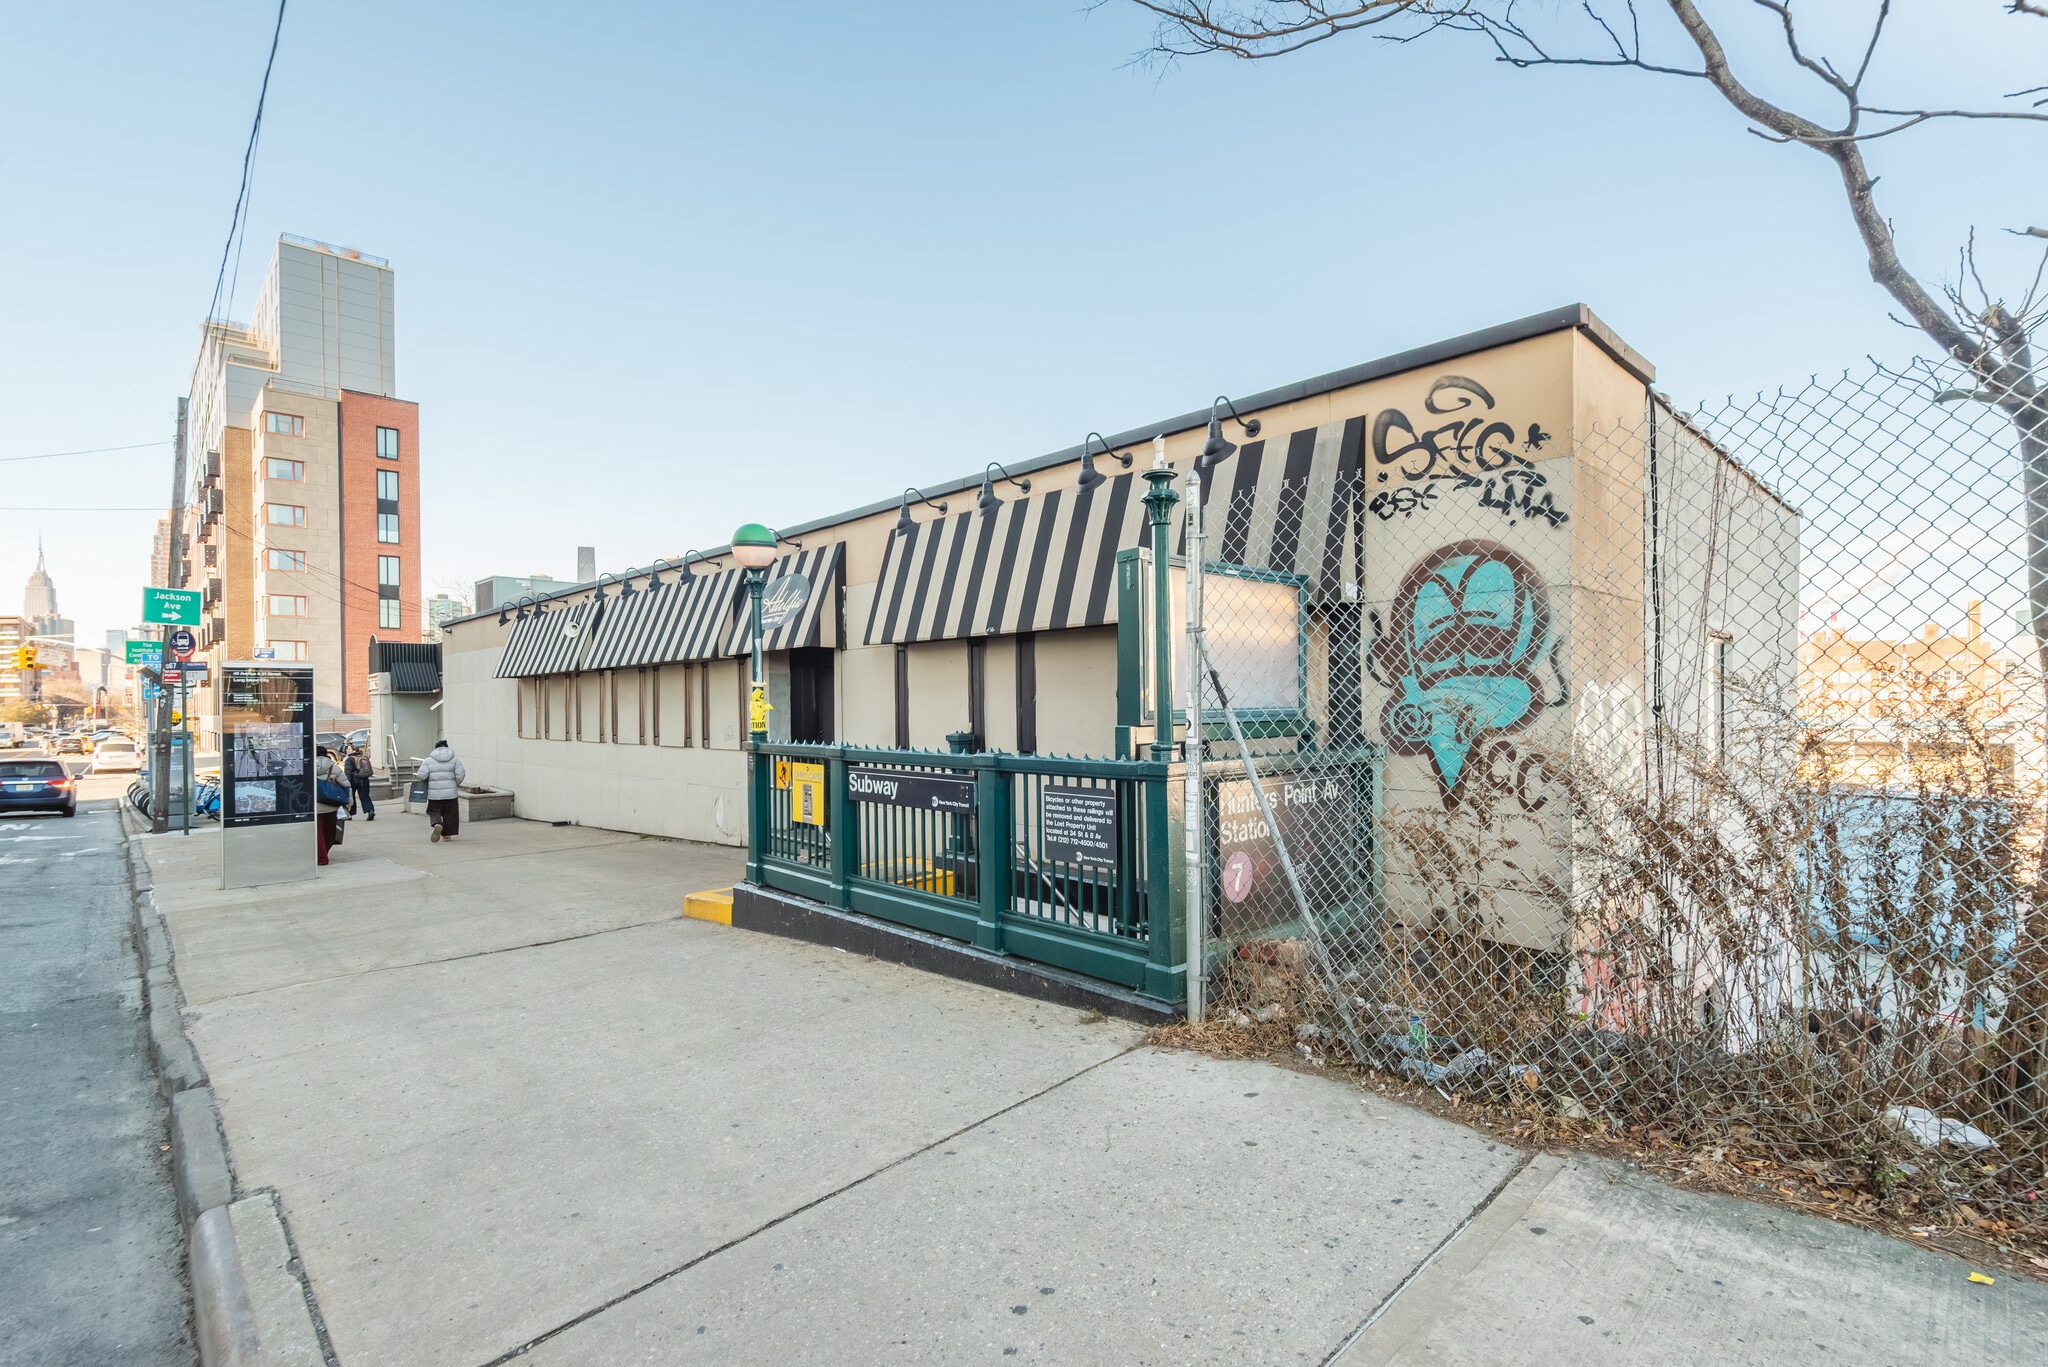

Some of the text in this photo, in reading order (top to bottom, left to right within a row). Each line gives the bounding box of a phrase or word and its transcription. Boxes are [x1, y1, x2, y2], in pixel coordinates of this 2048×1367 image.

[154, 592, 191, 602] Jackson
[849, 774, 898, 800] Subway
[1284, 782, 1317, 806] Point
[1323, 780, 1338, 800] Av
[1066, 822, 1086, 830] Property
[1232, 863, 1243, 892] 7
